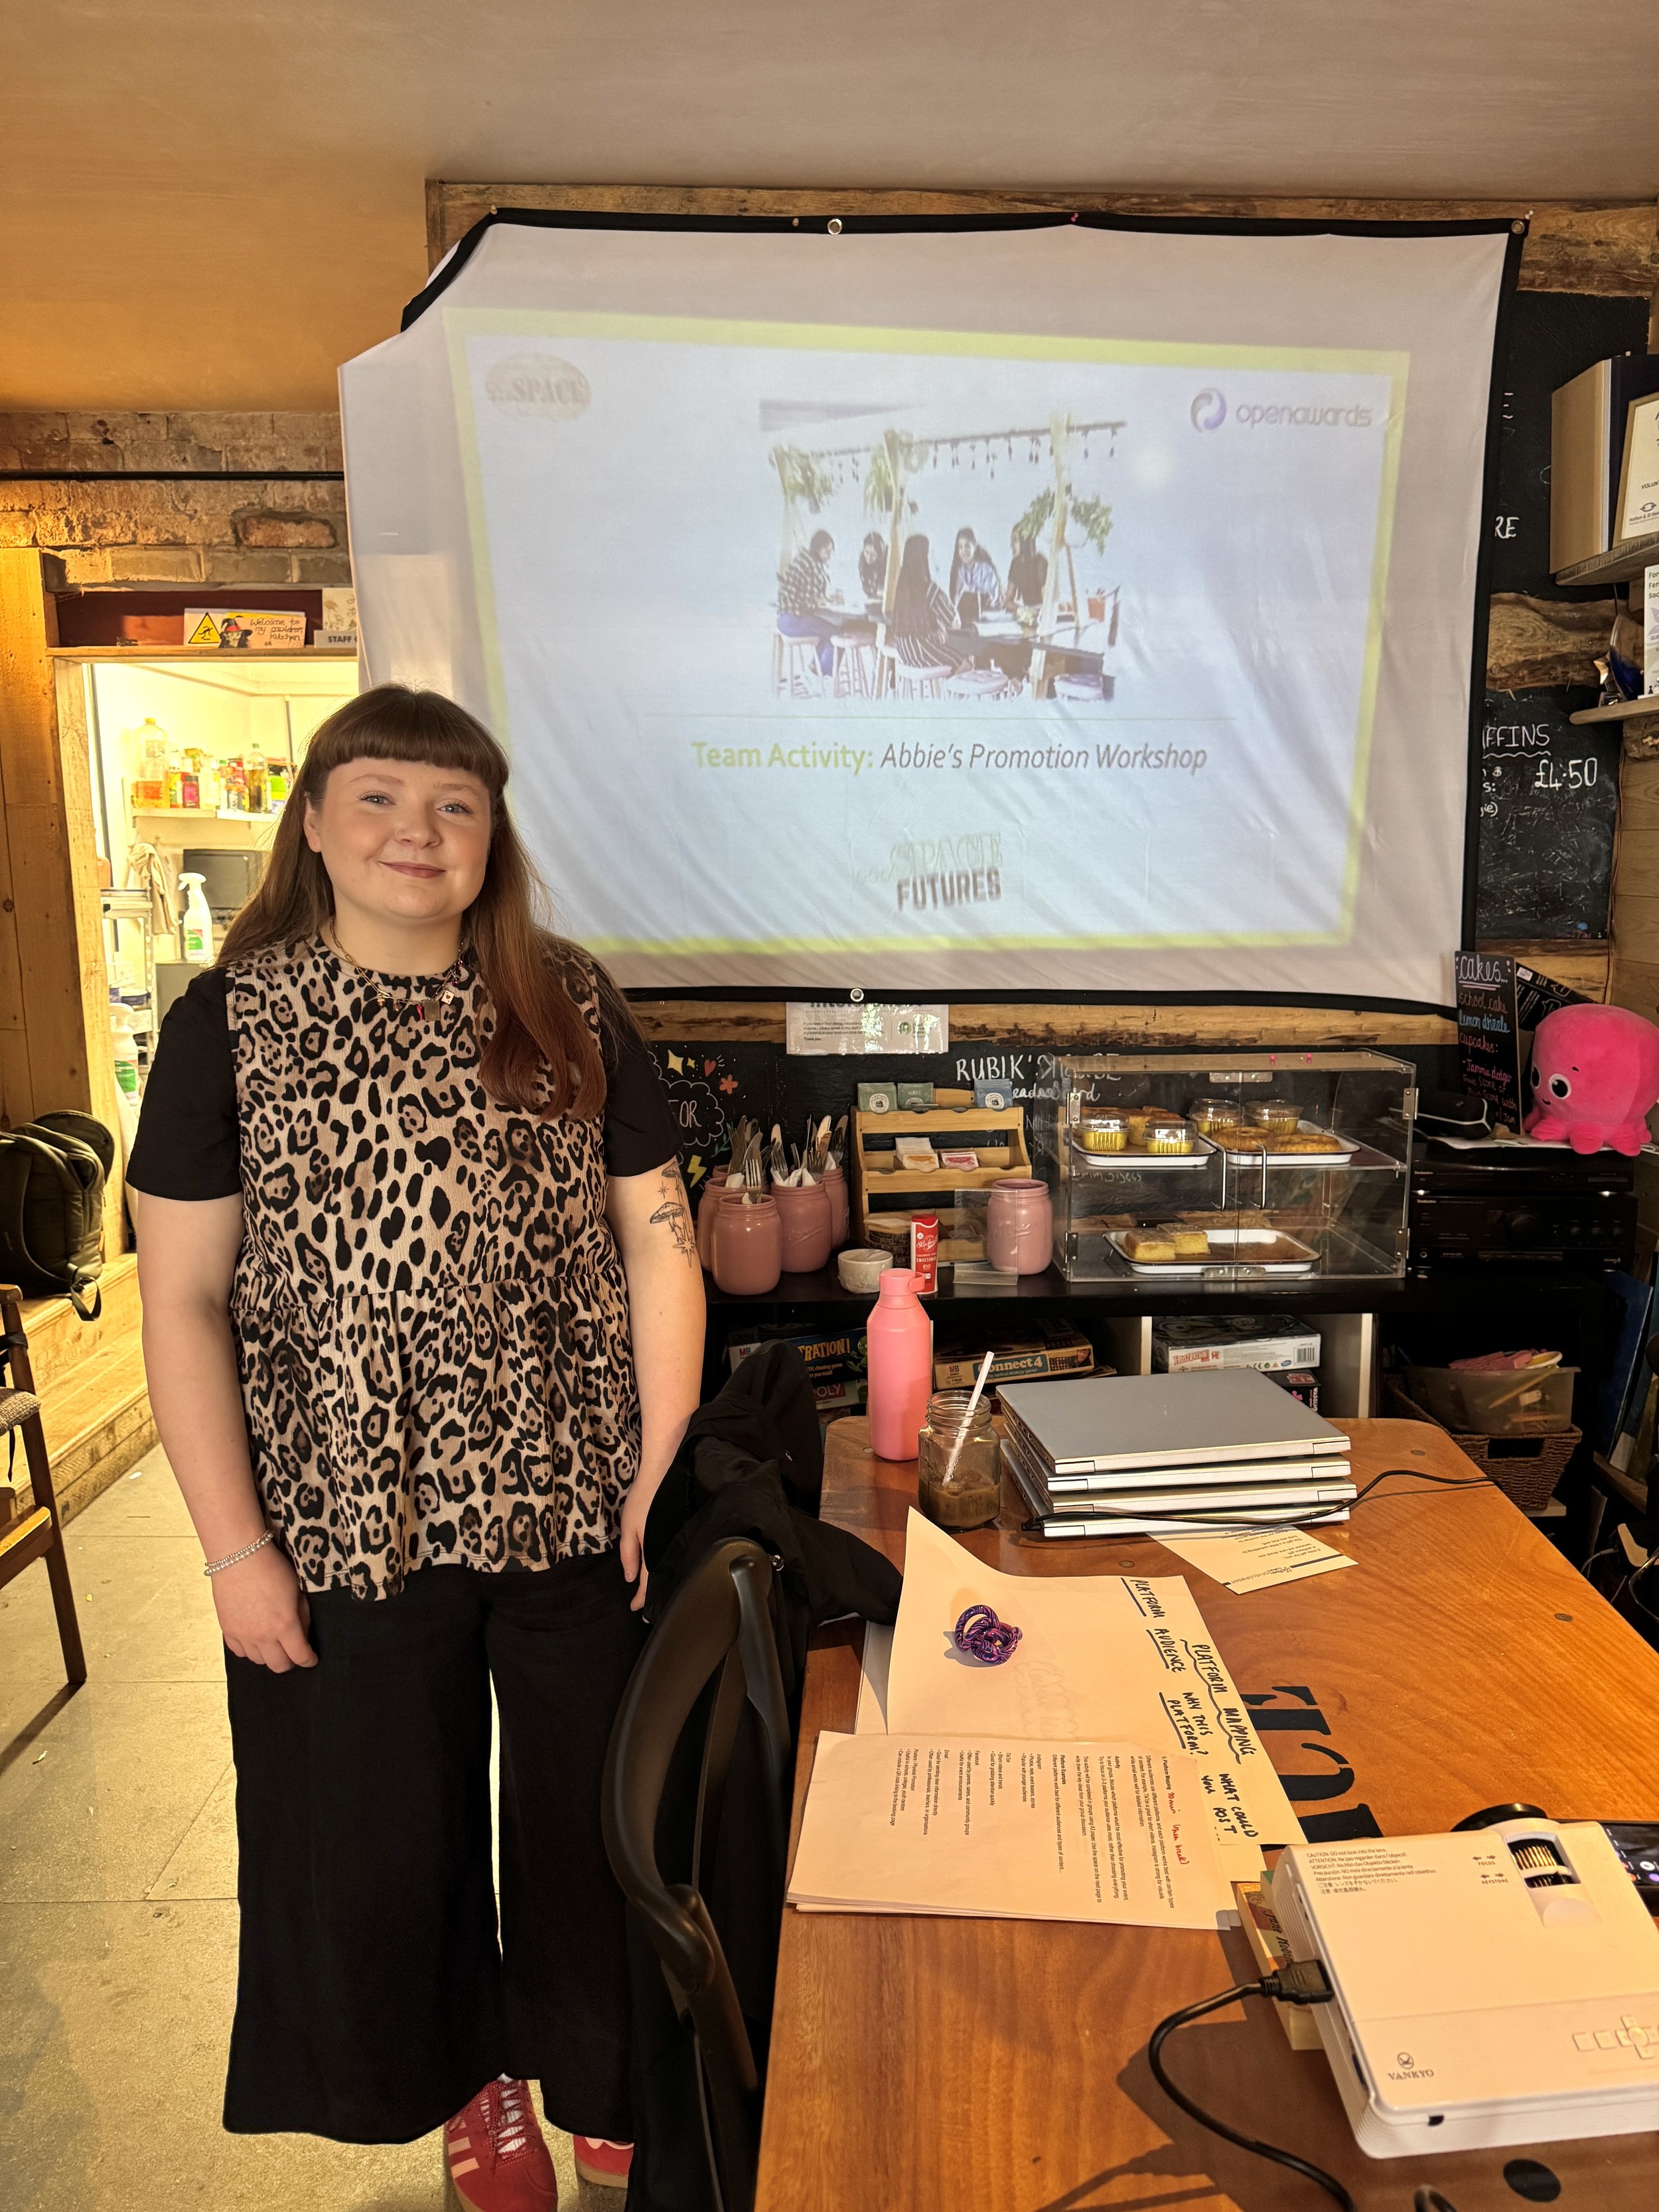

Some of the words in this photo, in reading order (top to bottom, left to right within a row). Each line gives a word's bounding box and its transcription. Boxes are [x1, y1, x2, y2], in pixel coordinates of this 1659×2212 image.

[1236, 404, 1372, 428] openawards
[250, 618, 285, 627] Welcome
[255, 627, 265, 635] my
[271, 624, 303, 633] cauldron
[1482, 723, 1550, 749] FFINS
[691, 743, 761, 768] Team
[768, 742, 873, 775] Activity:
[880, 742, 963, 769] Abbie's
[970, 743, 1090, 769] Promotion
[1096, 743, 1208, 776] Workshop
[897, 865, 1001, 913] FUTURES
[949, 1364, 960, 1373] MB
[1033, 1355, 1043, 1368] 4
[1173, 1349, 1210, 1365] FRUSTRATION!
[814, 1383, 842, 1398] OLY
[1130, 1580, 1165, 1618] PLATFORM
[1155, 1629, 1187, 1672] AUDIENCE
[1183, 1692, 1202, 1710] WHY
[1192, 1644, 1228, 1694] PLATFORM
[1222, 1708, 1258, 1756] MAPPING
[1167, 1700, 1209, 1755] PLATFORM?
[1192, 1714, 1214, 1736] THIS
[1218, 1773, 1240, 1803] WHAT
[1231, 1806, 1259, 1838] COULD
[1387, 2069, 1434, 2081] VANKYO
